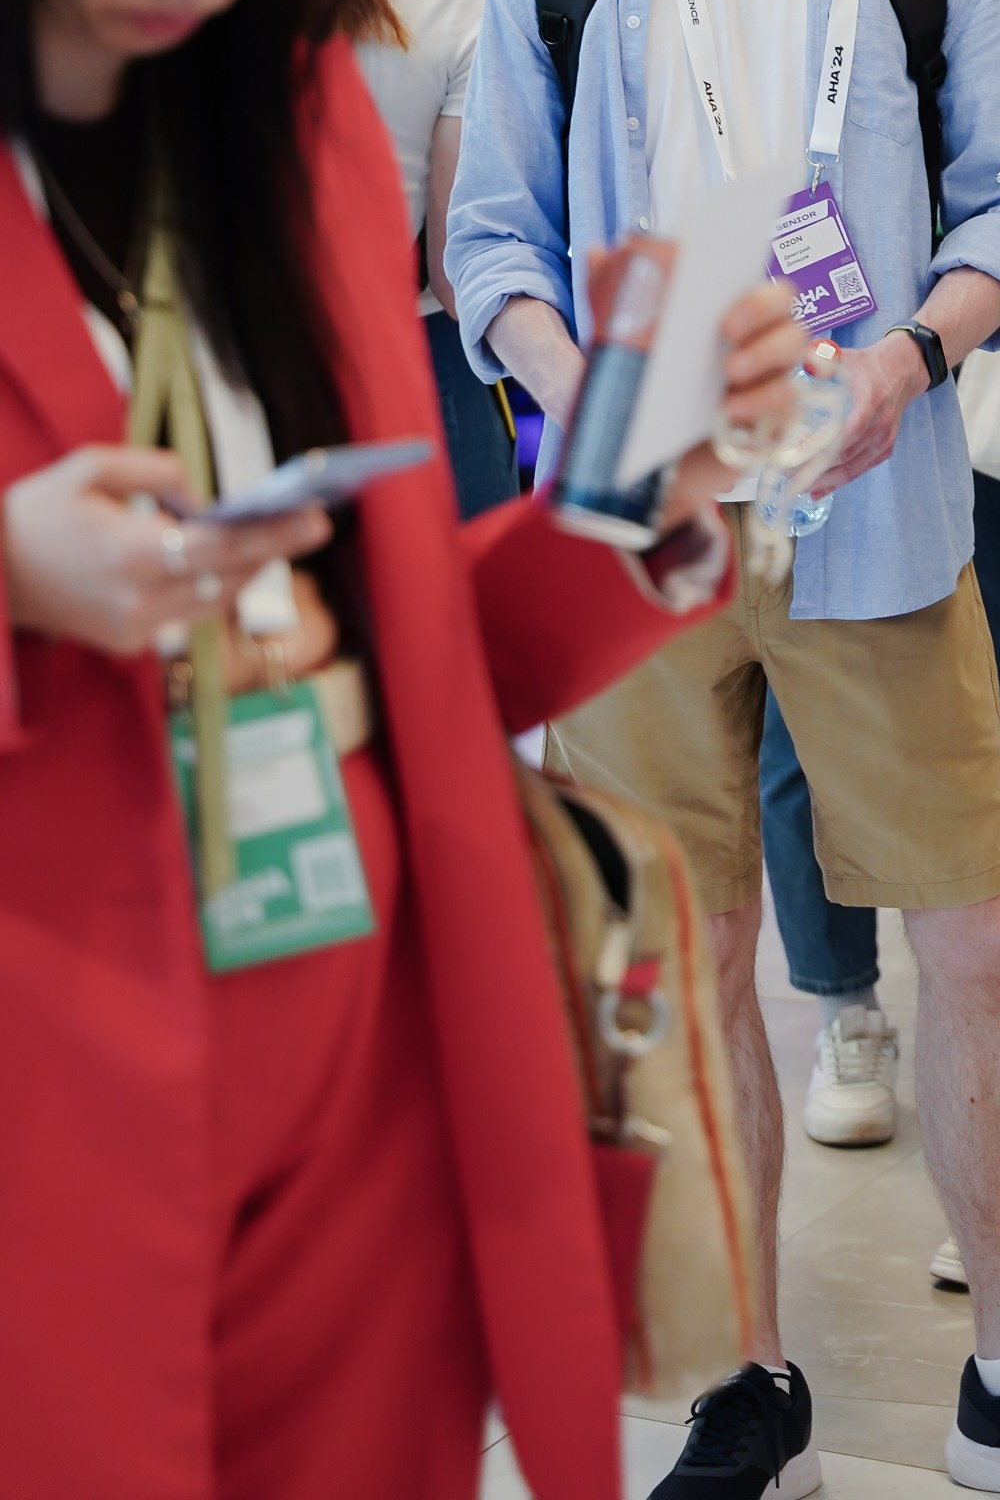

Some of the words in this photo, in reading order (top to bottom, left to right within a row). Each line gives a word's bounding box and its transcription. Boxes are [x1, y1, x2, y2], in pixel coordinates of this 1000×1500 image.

[827, 45, 844, 104] AHA'24
[702, 80, 723, 135] AHA'24
[775, 210, 817, 231] SENIOR
[779, 235, 803, 250] OZON
